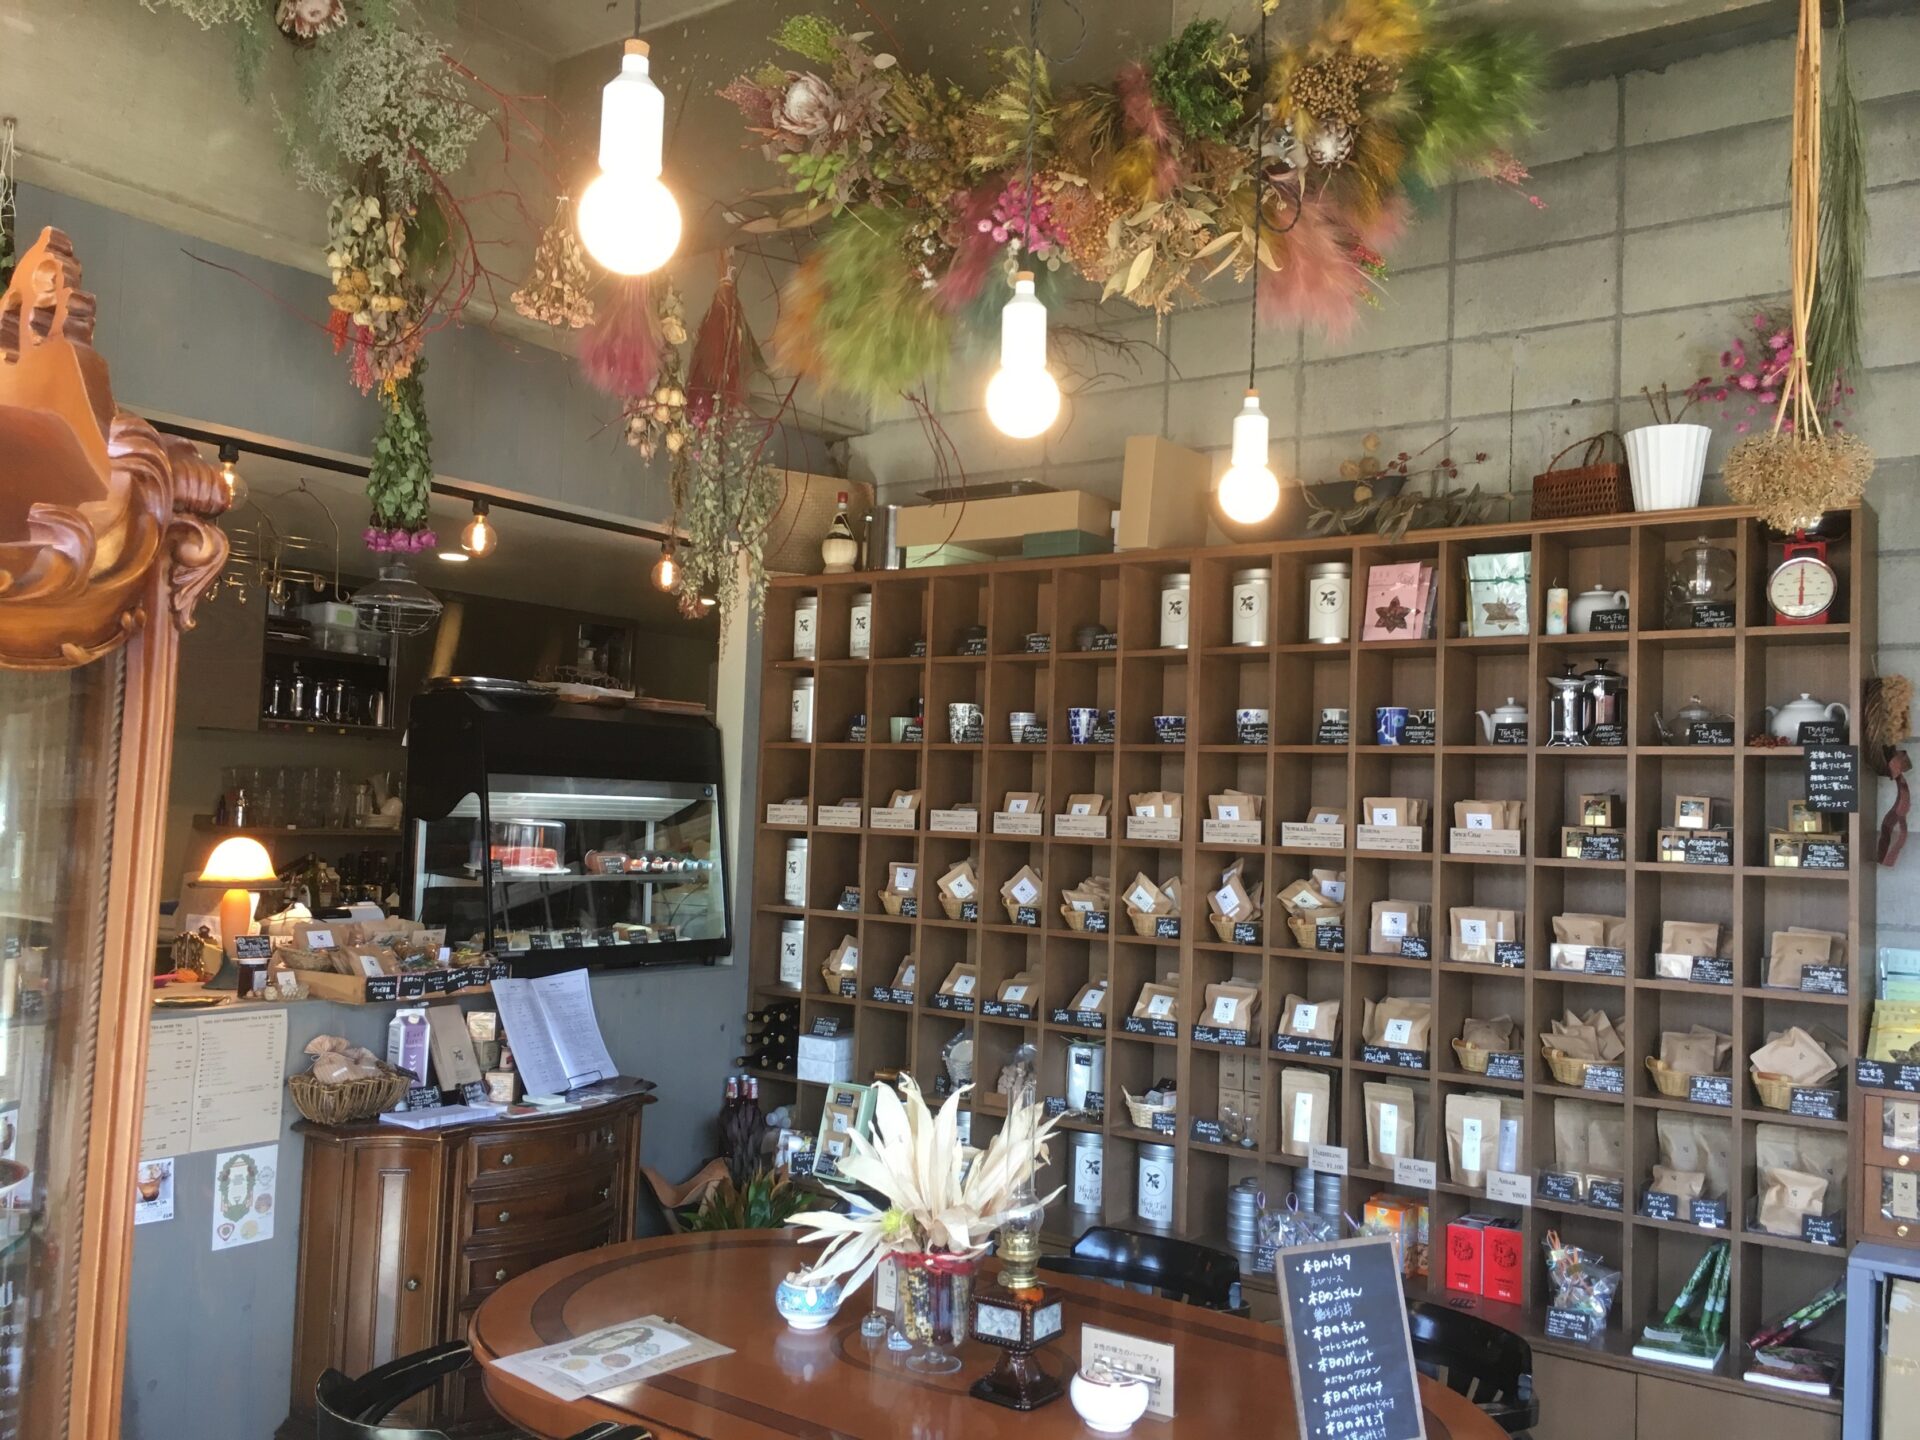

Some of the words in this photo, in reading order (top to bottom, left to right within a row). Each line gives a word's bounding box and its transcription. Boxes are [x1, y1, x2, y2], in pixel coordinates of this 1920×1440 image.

[1308, 1287, 1362, 1306] 本日のごはん
